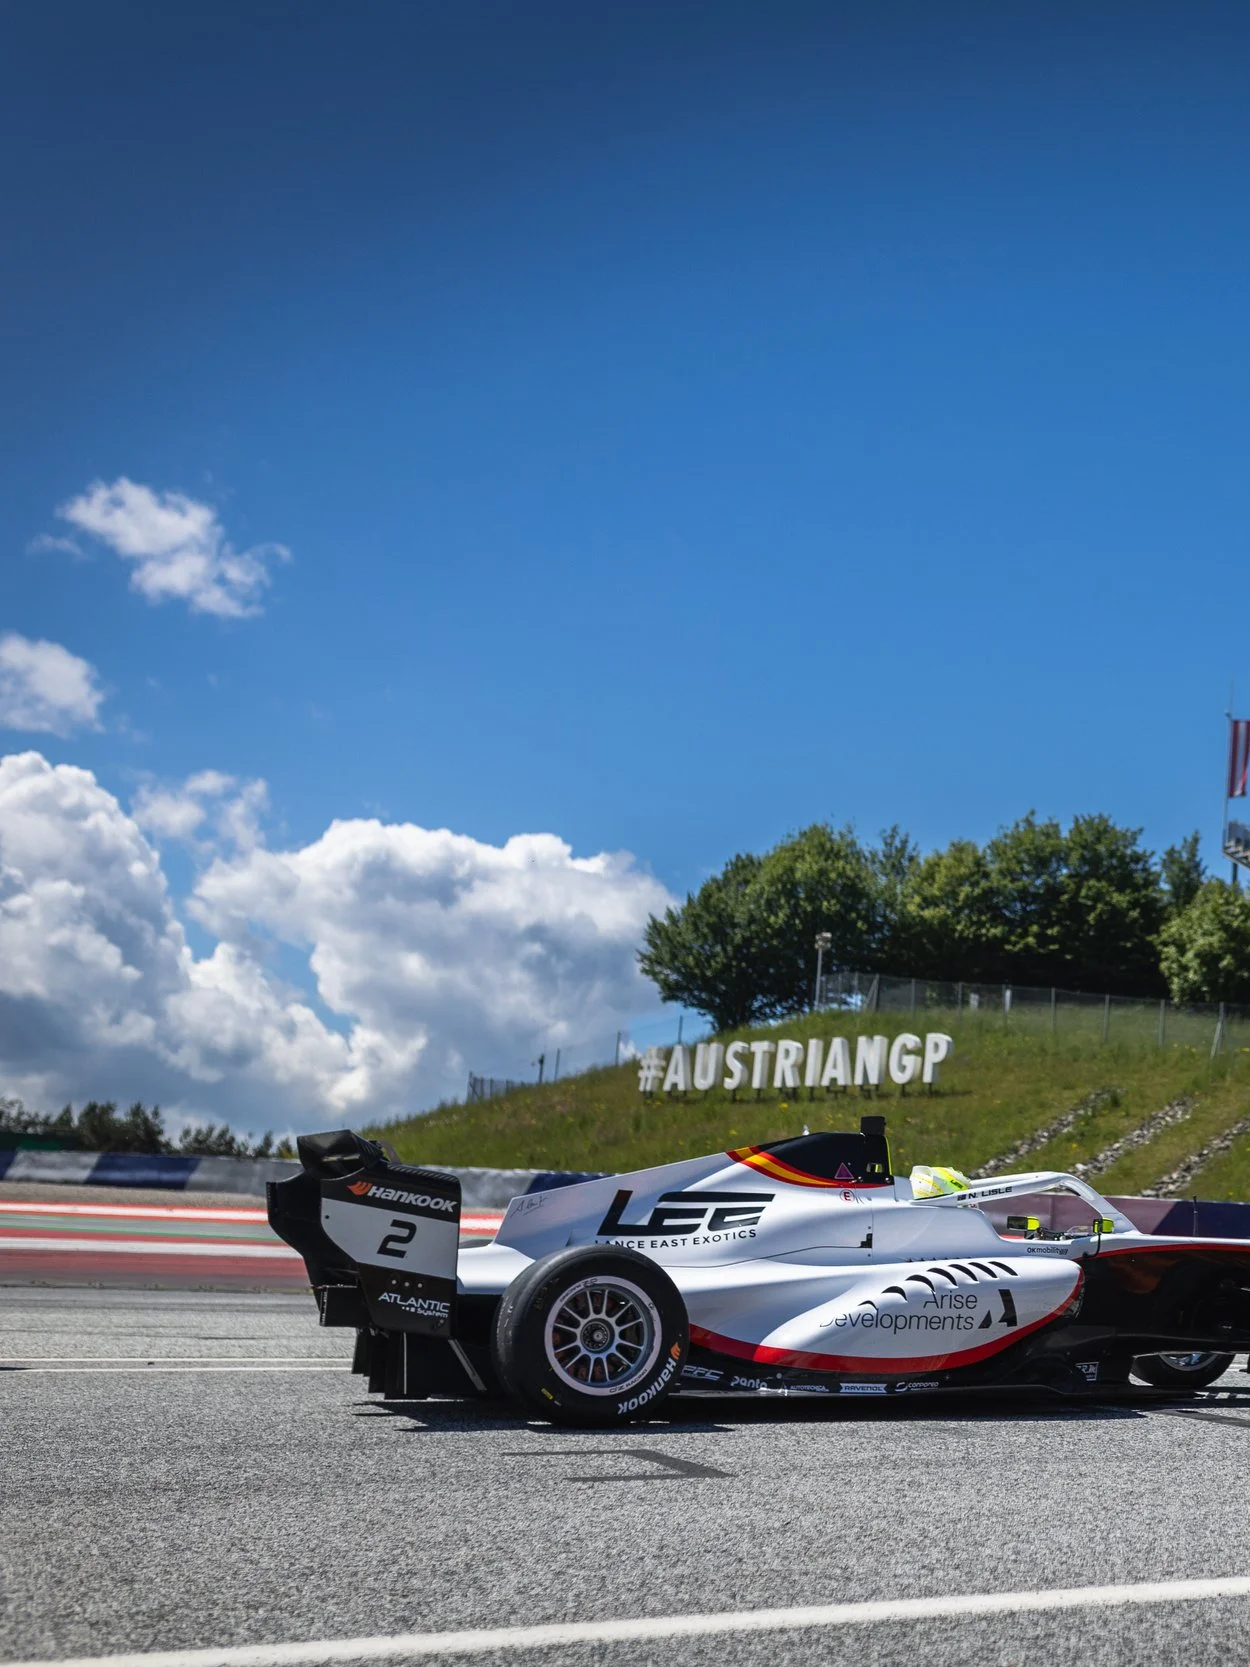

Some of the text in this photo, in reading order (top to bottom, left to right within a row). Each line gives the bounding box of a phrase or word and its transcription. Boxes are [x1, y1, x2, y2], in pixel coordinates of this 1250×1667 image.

[639, 1033, 953, 1092] #AUSTRIANGP
[981, 1186, 1013, 1197] LISLE
[597, 1189, 776, 1237] LEE
[376, 1218, 417, 1259] 2
[650, 1238, 688, 1249] EAST
[693, 1228, 757, 1246] EXOTICS
[378, 1292, 451, 1313] ATLANTIC
[923, 1290, 978, 1310] Arise
[819, 1308, 975, 1335] evelopments
